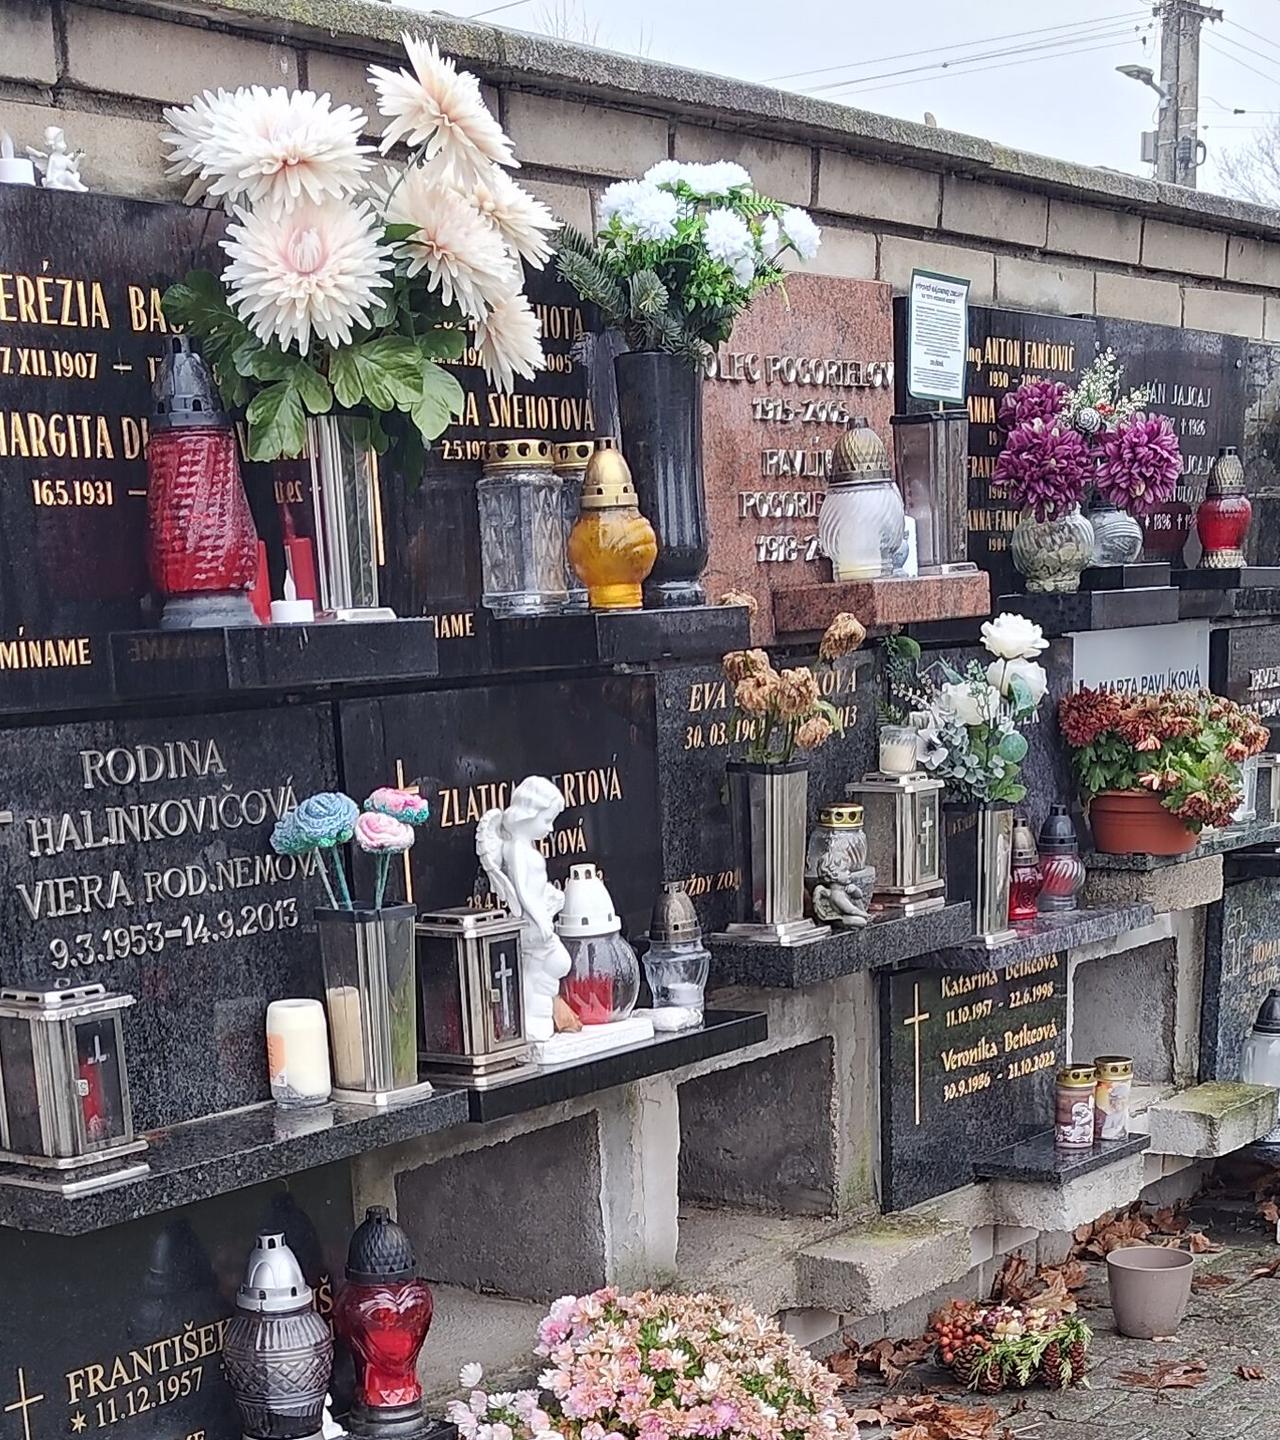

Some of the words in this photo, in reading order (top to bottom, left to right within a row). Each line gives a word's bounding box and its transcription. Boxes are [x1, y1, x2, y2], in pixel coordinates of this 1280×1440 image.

[531, 303, 585, 341] HOTA
[983, 336, 1021, 368] ANTON
[31, 479, 114, 506] 16.5.1931
[688, 681, 726, 713] EVA
[79, 738, 227, 790] RODINA
[26, 775, 301, 859] HALINKOVIČOVÁ
[15, 869, 136, 921] VIERA
[95, 1365, 204, 1428] 11.12.1957
